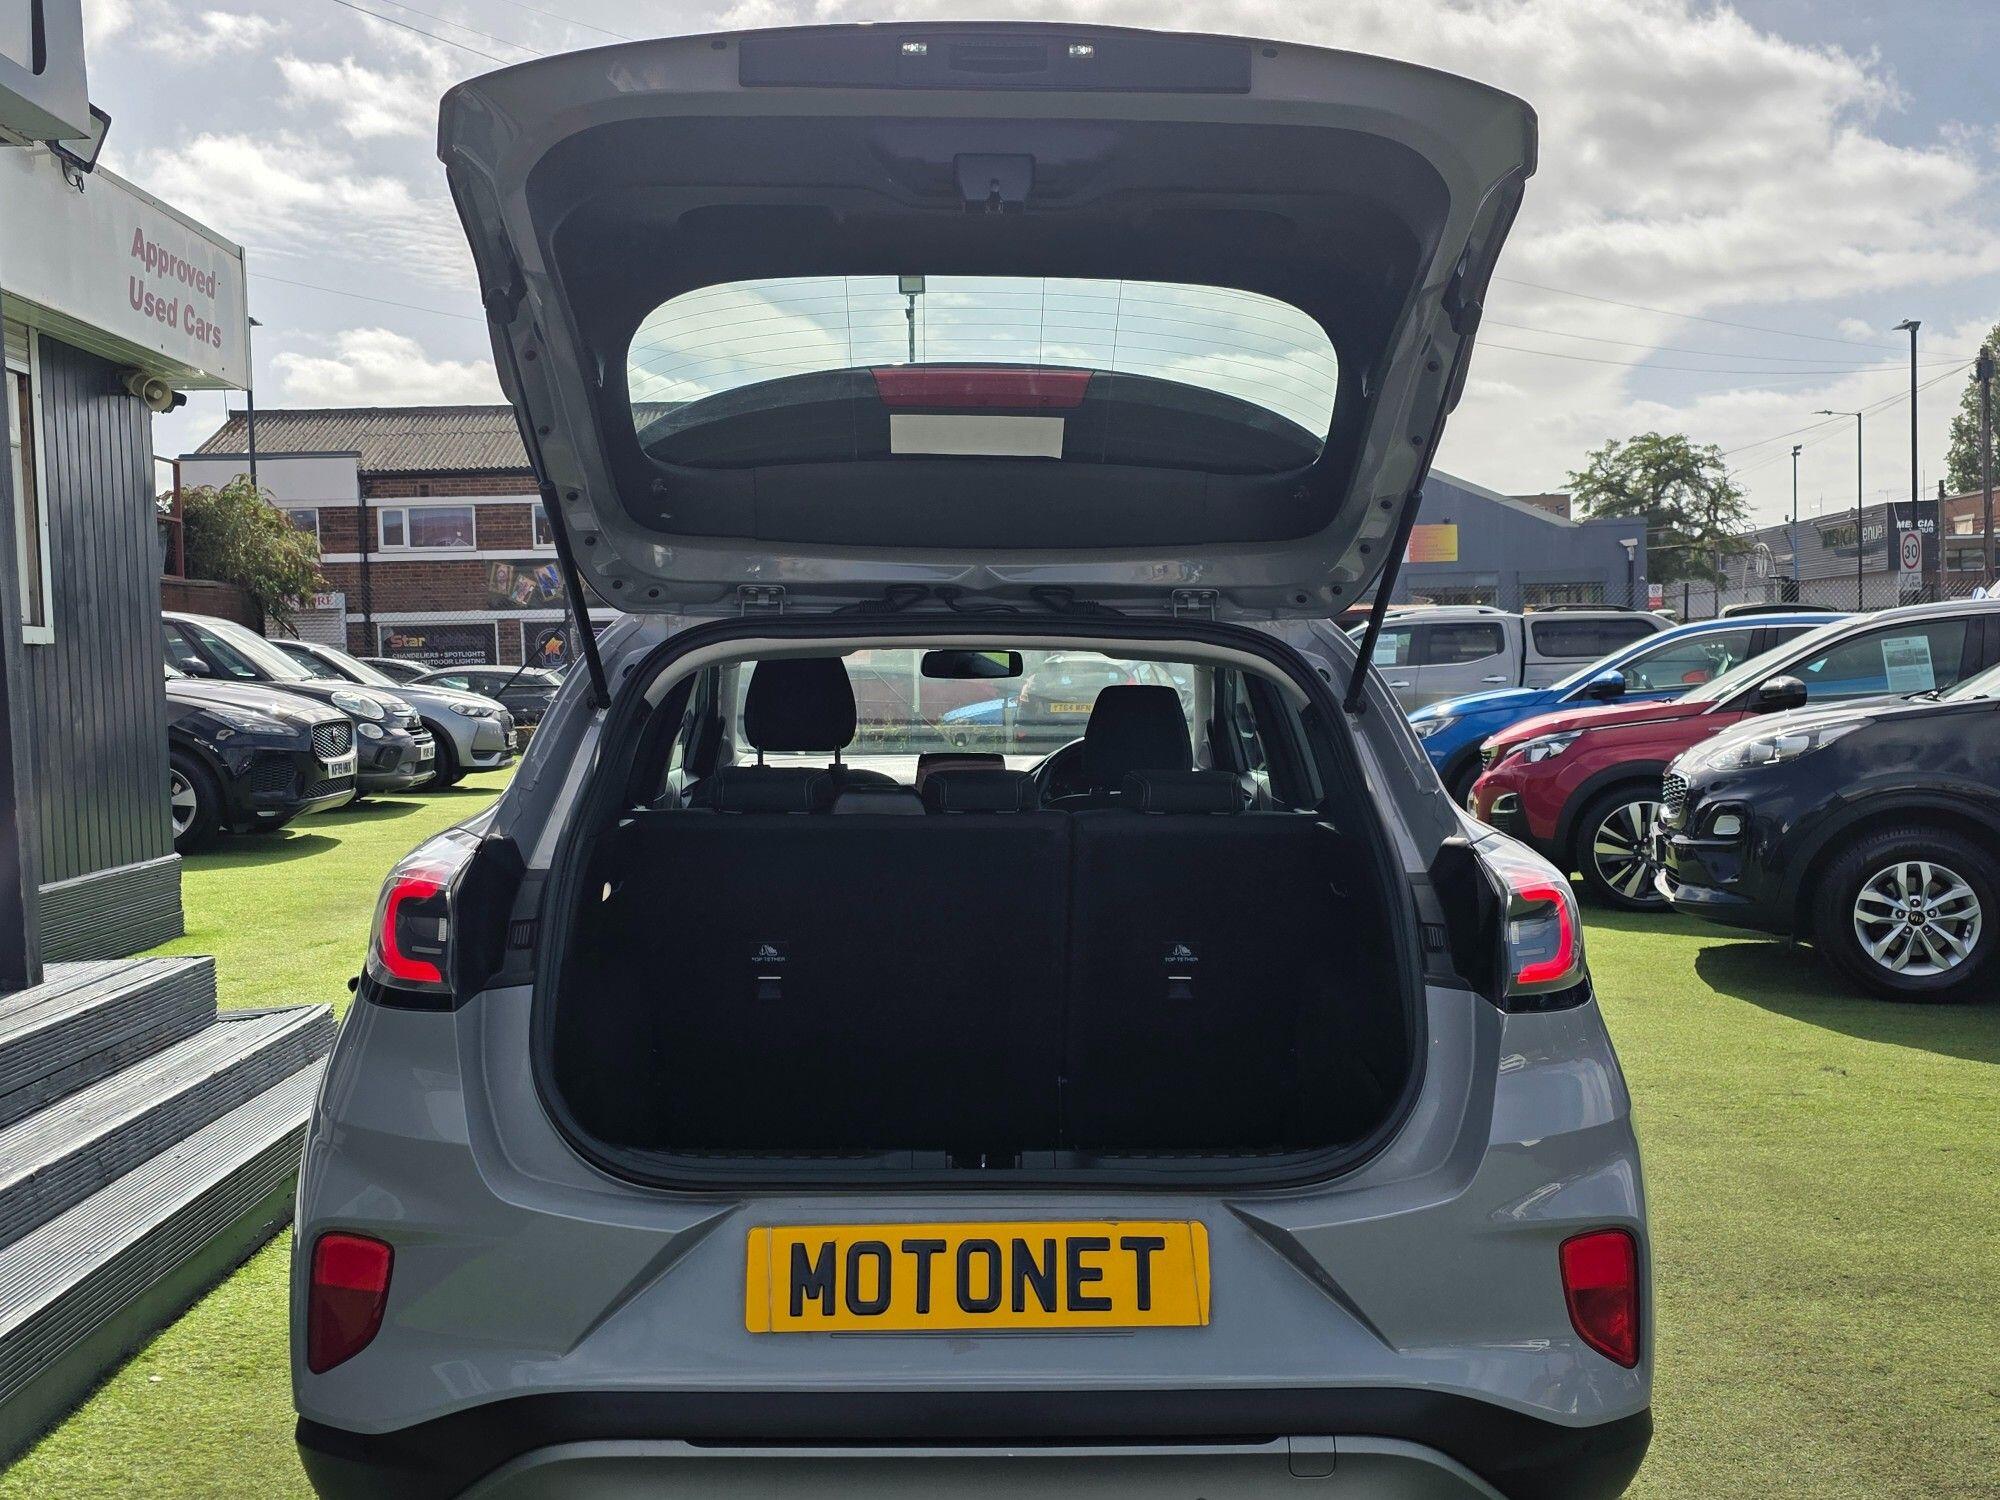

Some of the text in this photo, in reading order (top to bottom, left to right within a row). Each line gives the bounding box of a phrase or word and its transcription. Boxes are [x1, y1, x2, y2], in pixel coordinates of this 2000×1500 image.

[131, 227, 216, 299] Approved
[129, 275, 221, 349] Used Cars
[1904, 544, 1918, 559] 30
[390, 634, 426, 648] Star
[392, 650, 486, 660] CHANDELIERS SPOTLIGHTS
[789, 1236, 1166, 1317] MOTONET
